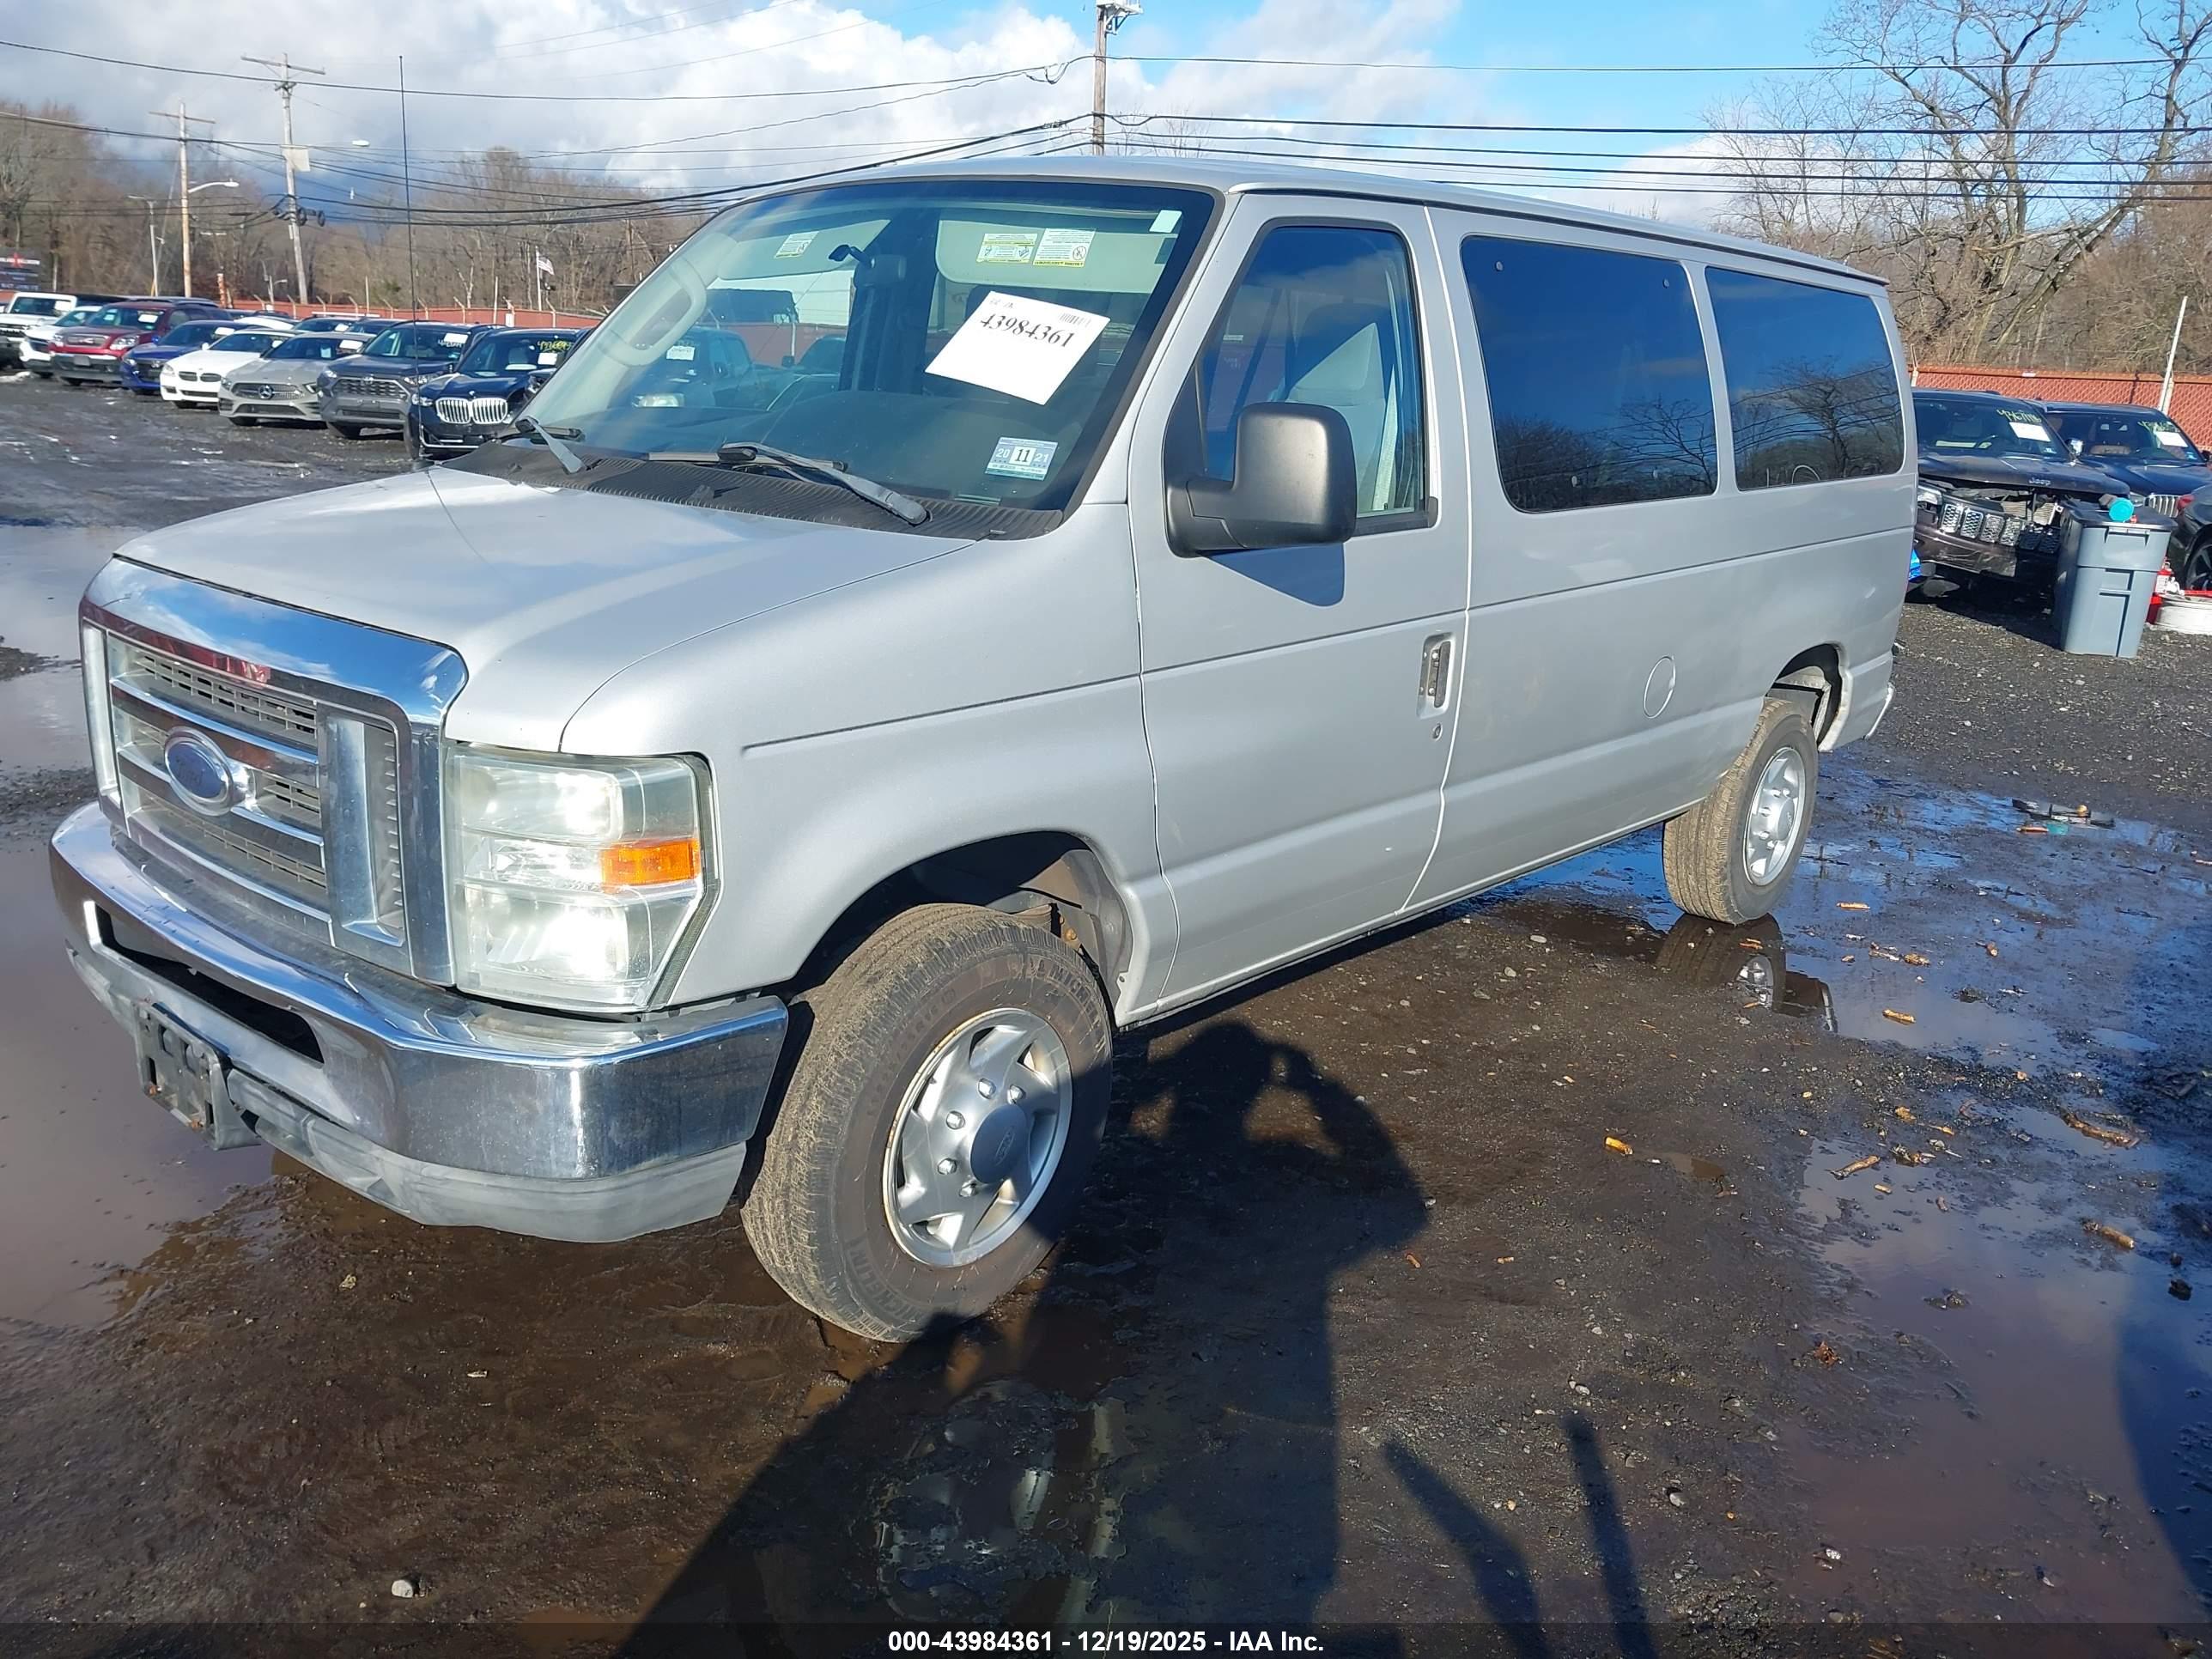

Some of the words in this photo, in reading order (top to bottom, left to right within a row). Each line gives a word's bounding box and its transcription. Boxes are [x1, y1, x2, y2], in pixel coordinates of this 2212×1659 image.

[980, 313, 1075, 348] 43984361
[995, 448, 1011, 459] 20
[1014, 448, 1030, 463] 11
[1033, 453, 1049, 463] 21
[2027, 477, 2051, 487] Jeep
